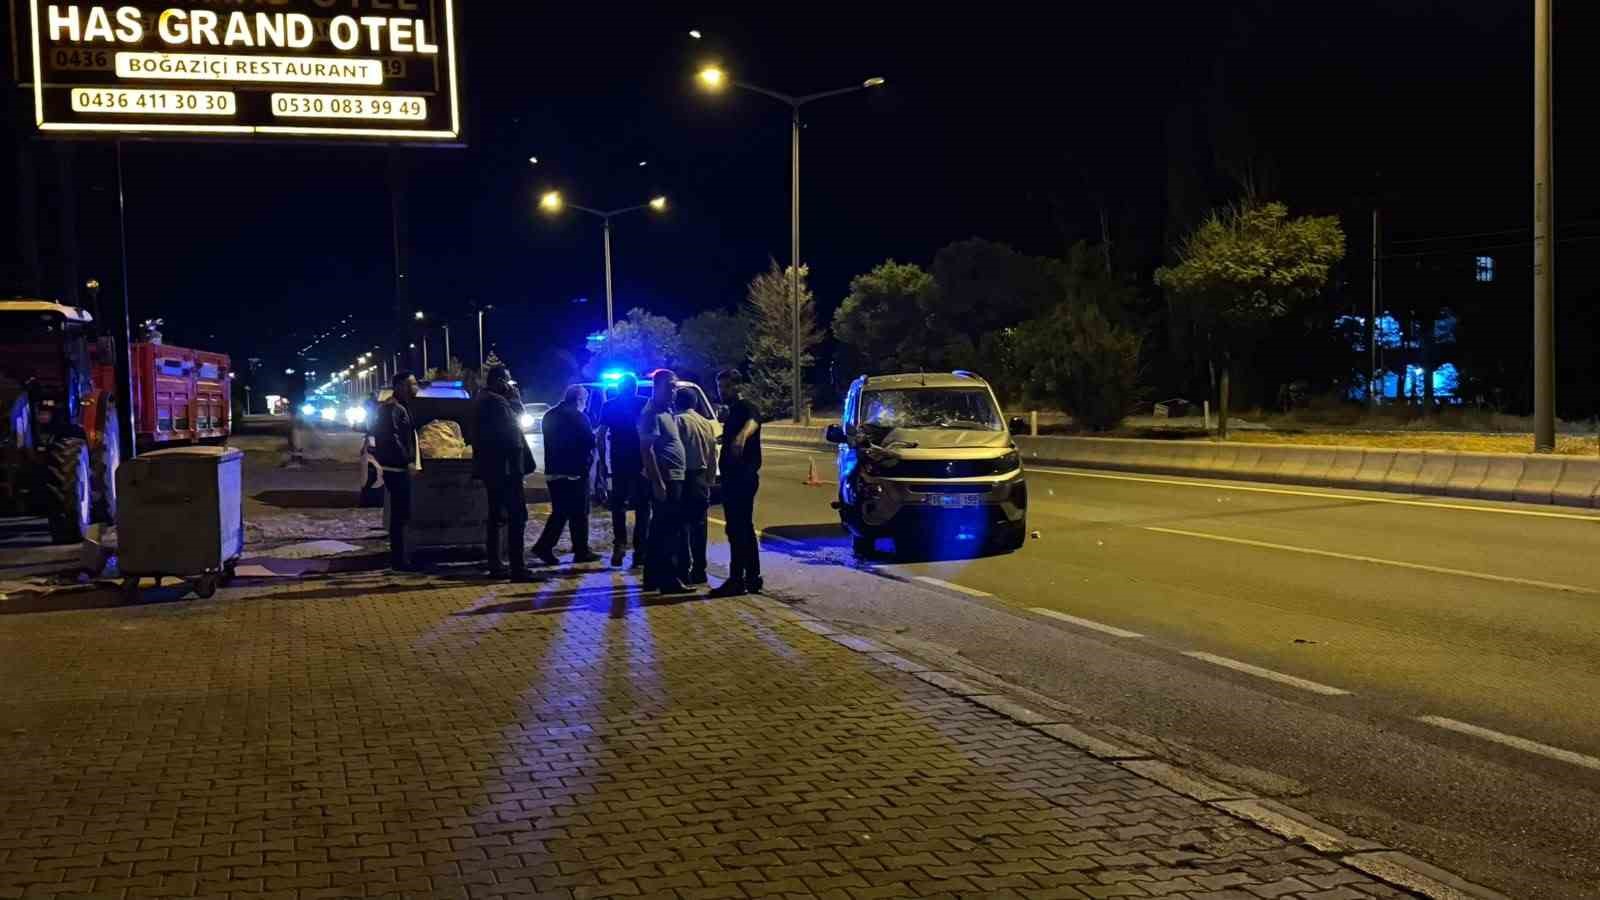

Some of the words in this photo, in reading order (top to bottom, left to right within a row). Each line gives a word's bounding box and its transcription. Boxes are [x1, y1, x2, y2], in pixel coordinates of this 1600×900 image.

[48, 5, 143, 43] HAS
[158, 7, 313, 48] GRAND
[328, 14, 439, 53] OTEL
[128, 55, 228, 78] BOĞAZİÇİ
[236, 61, 368, 78] RESTAURANT
[79, 92, 128, 108] 0436
[136, 94, 167, 108] 411
[175, 94, 197, 109] 30
[205, 95, 227, 110] 30
[277, 97, 323, 112] 0530
[331, 99, 363, 113] 083
[371, 100, 392, 114] 99
[400, 101, 421, 115] 49
